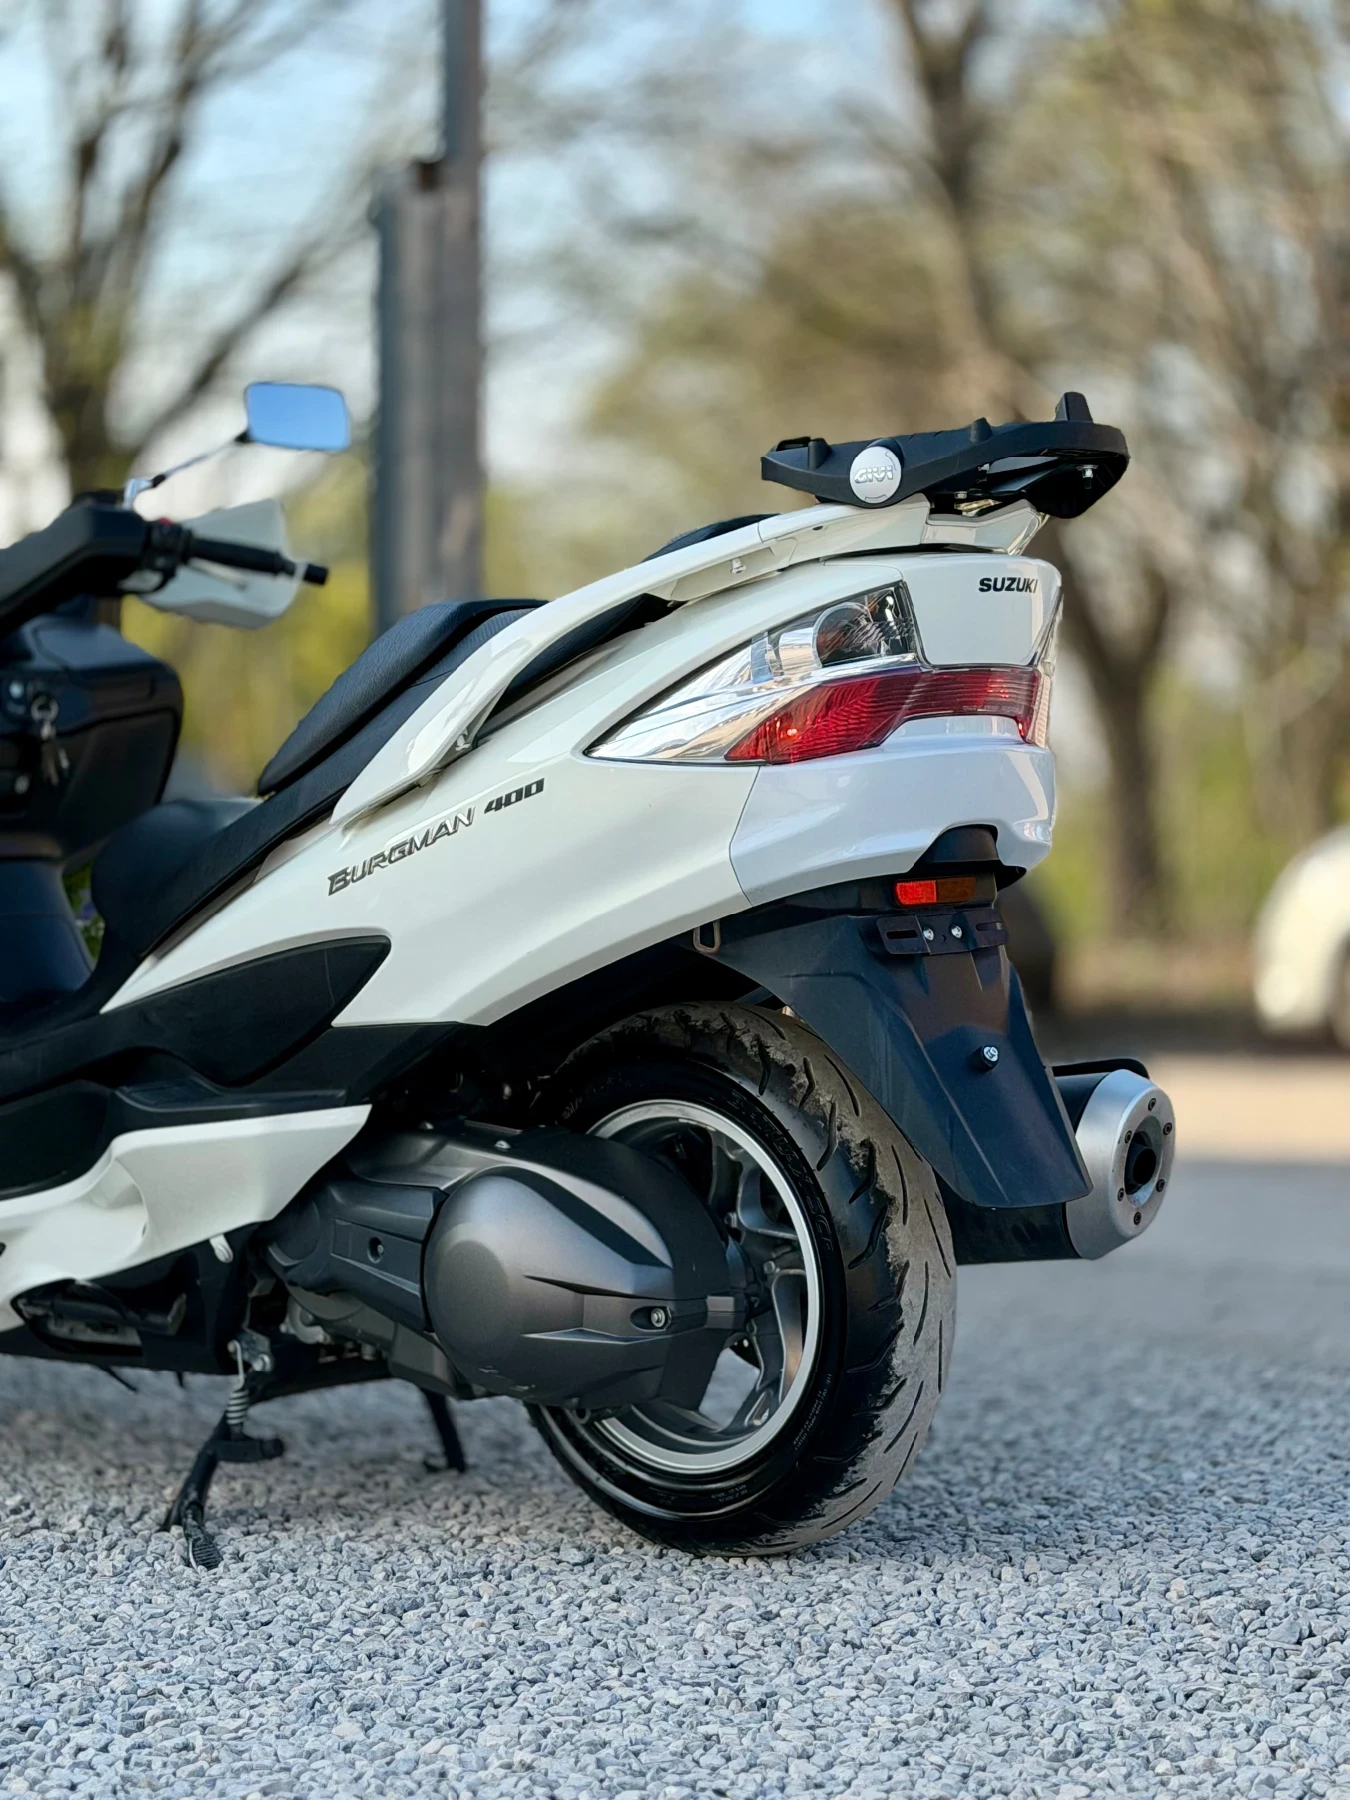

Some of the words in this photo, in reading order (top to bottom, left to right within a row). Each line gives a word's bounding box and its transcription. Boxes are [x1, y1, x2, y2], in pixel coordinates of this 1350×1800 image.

[978, 576, 1039, 594] SUZUKI
[327, 806, 476, 896] BURGMAN
[484, 778, 545, 814] 400
